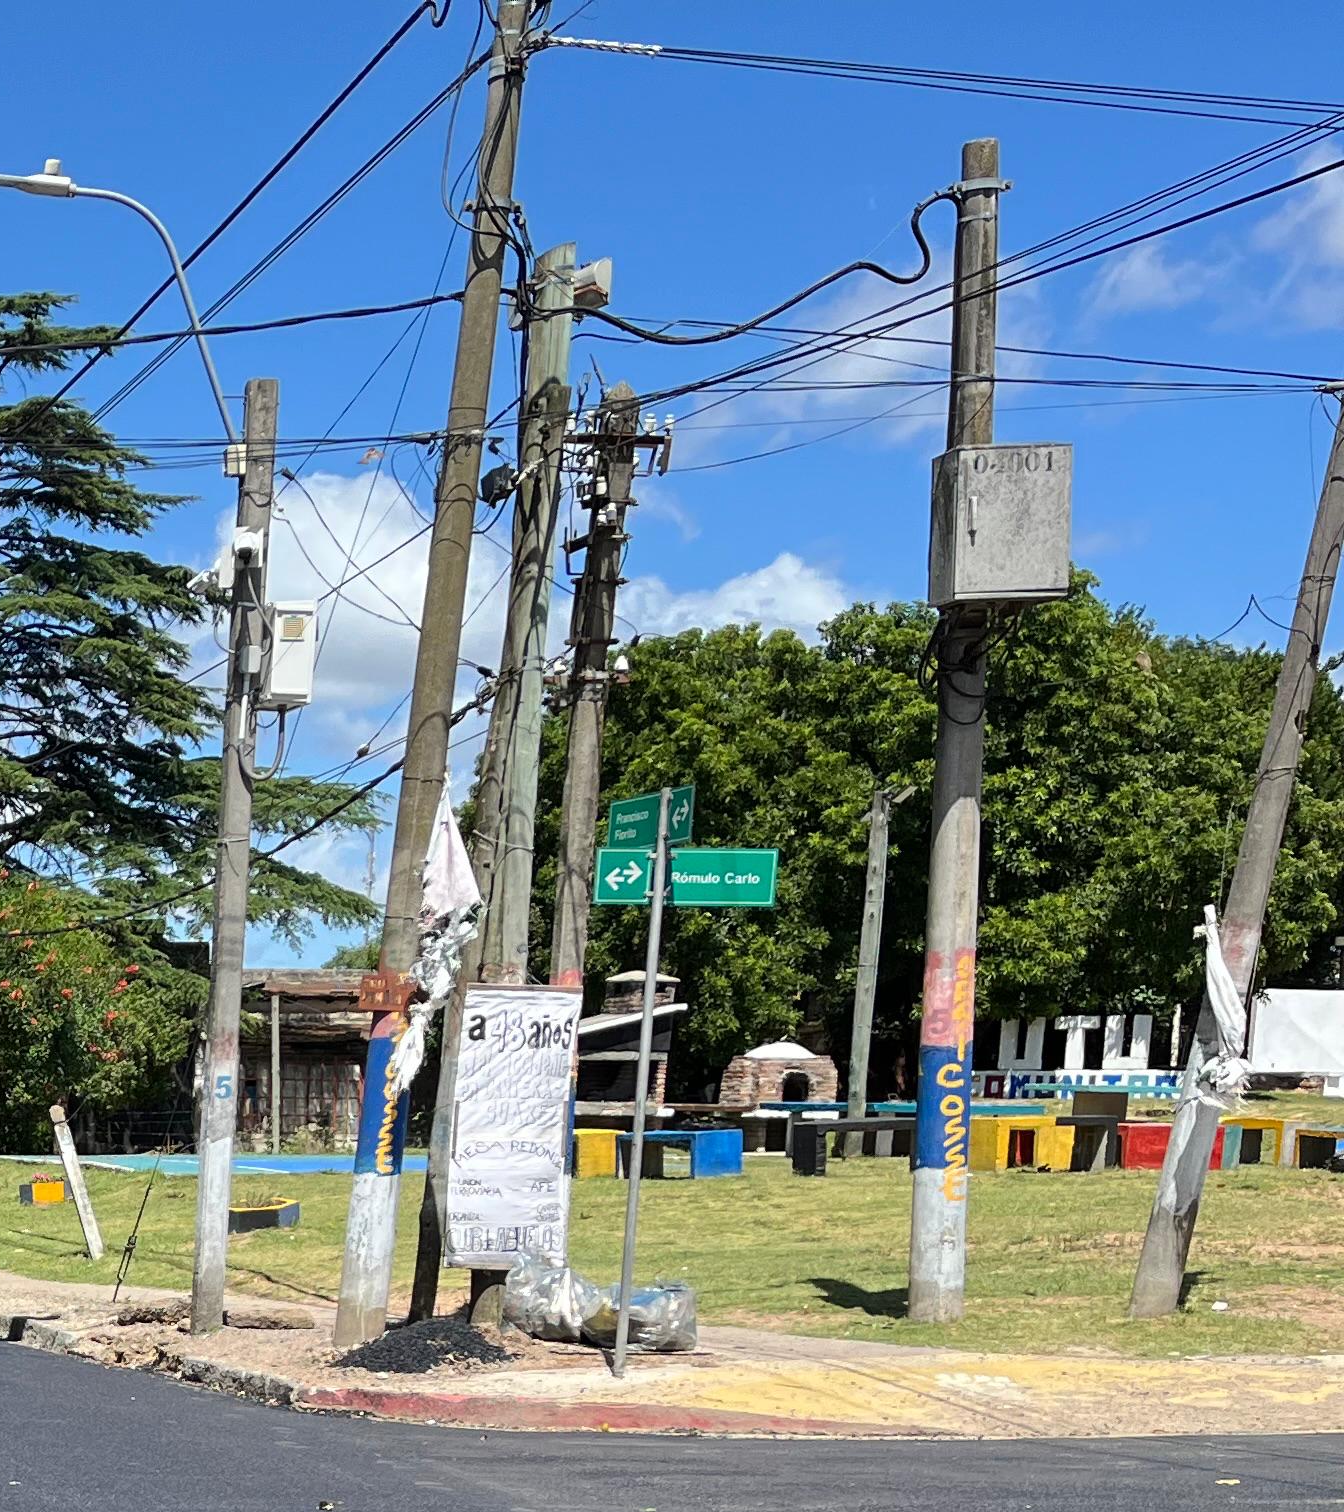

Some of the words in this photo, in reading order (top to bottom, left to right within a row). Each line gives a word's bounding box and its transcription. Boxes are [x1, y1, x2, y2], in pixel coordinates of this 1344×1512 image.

[671, 871, 721, 884] Rómulo
[724, 872, 761, 885] Carlo
[468, 1014, 486, 1041] a
[527, 1013, 573, 1050] años
[997, 1014, 1153, 1070] UTU
[214, 1075, 233, 1099] 5
[936, 1063, 967, 1201] COSSE
[452, 1140, 506, 1169] MESA
[530, 1180, 556, 1193] AFE
[445, 1226, 484, 1253] CLUB
